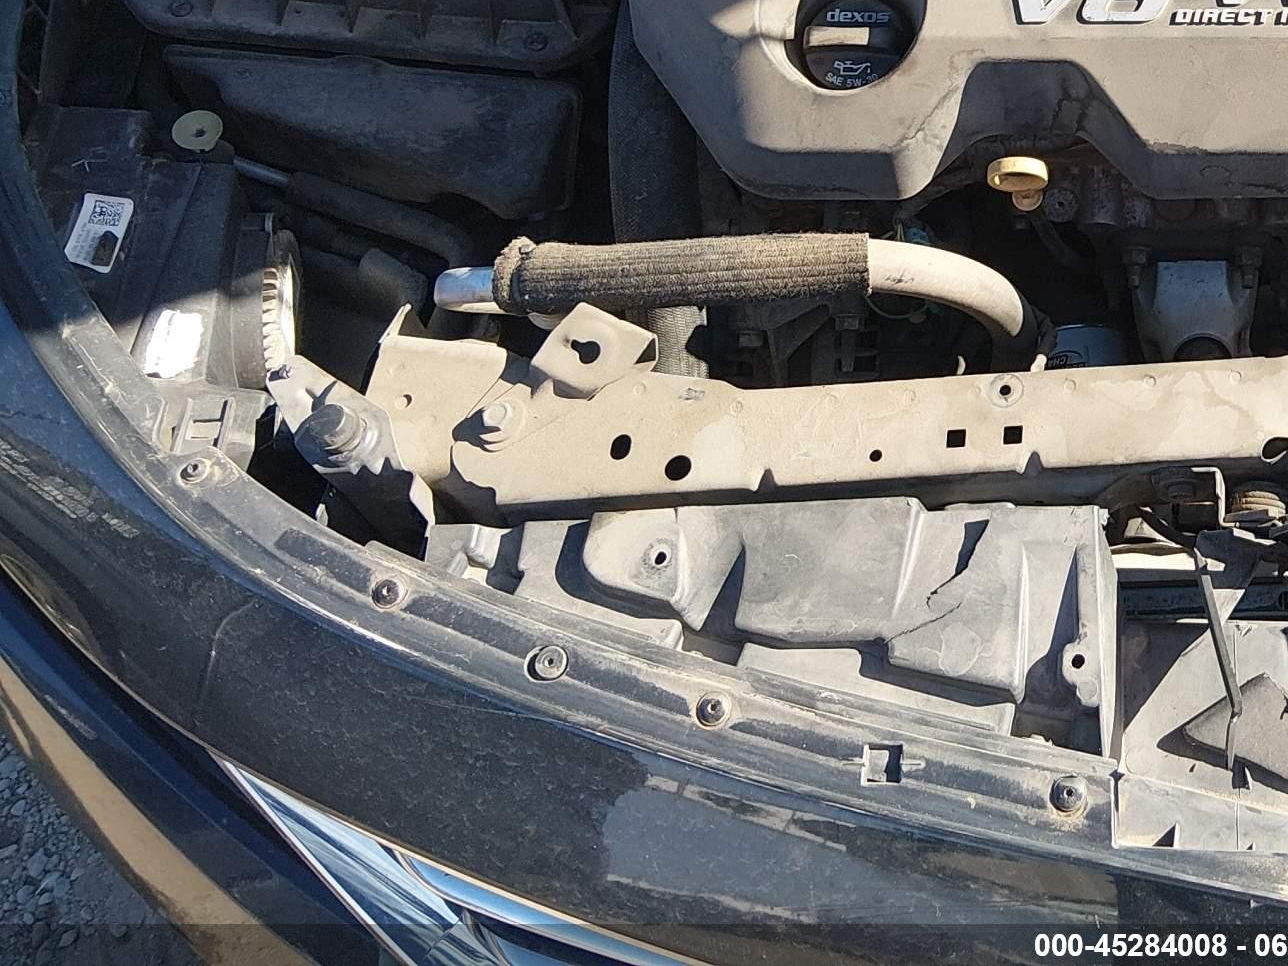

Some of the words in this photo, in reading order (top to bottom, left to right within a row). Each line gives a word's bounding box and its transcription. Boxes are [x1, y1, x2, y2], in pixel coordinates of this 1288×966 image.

[826, 8, 890, 23] dexos
[1168, 8, 1272, 26] DIRECT
[825, 72, 843, 86] SAE
[846, 73, 878, 88] 5W-30
